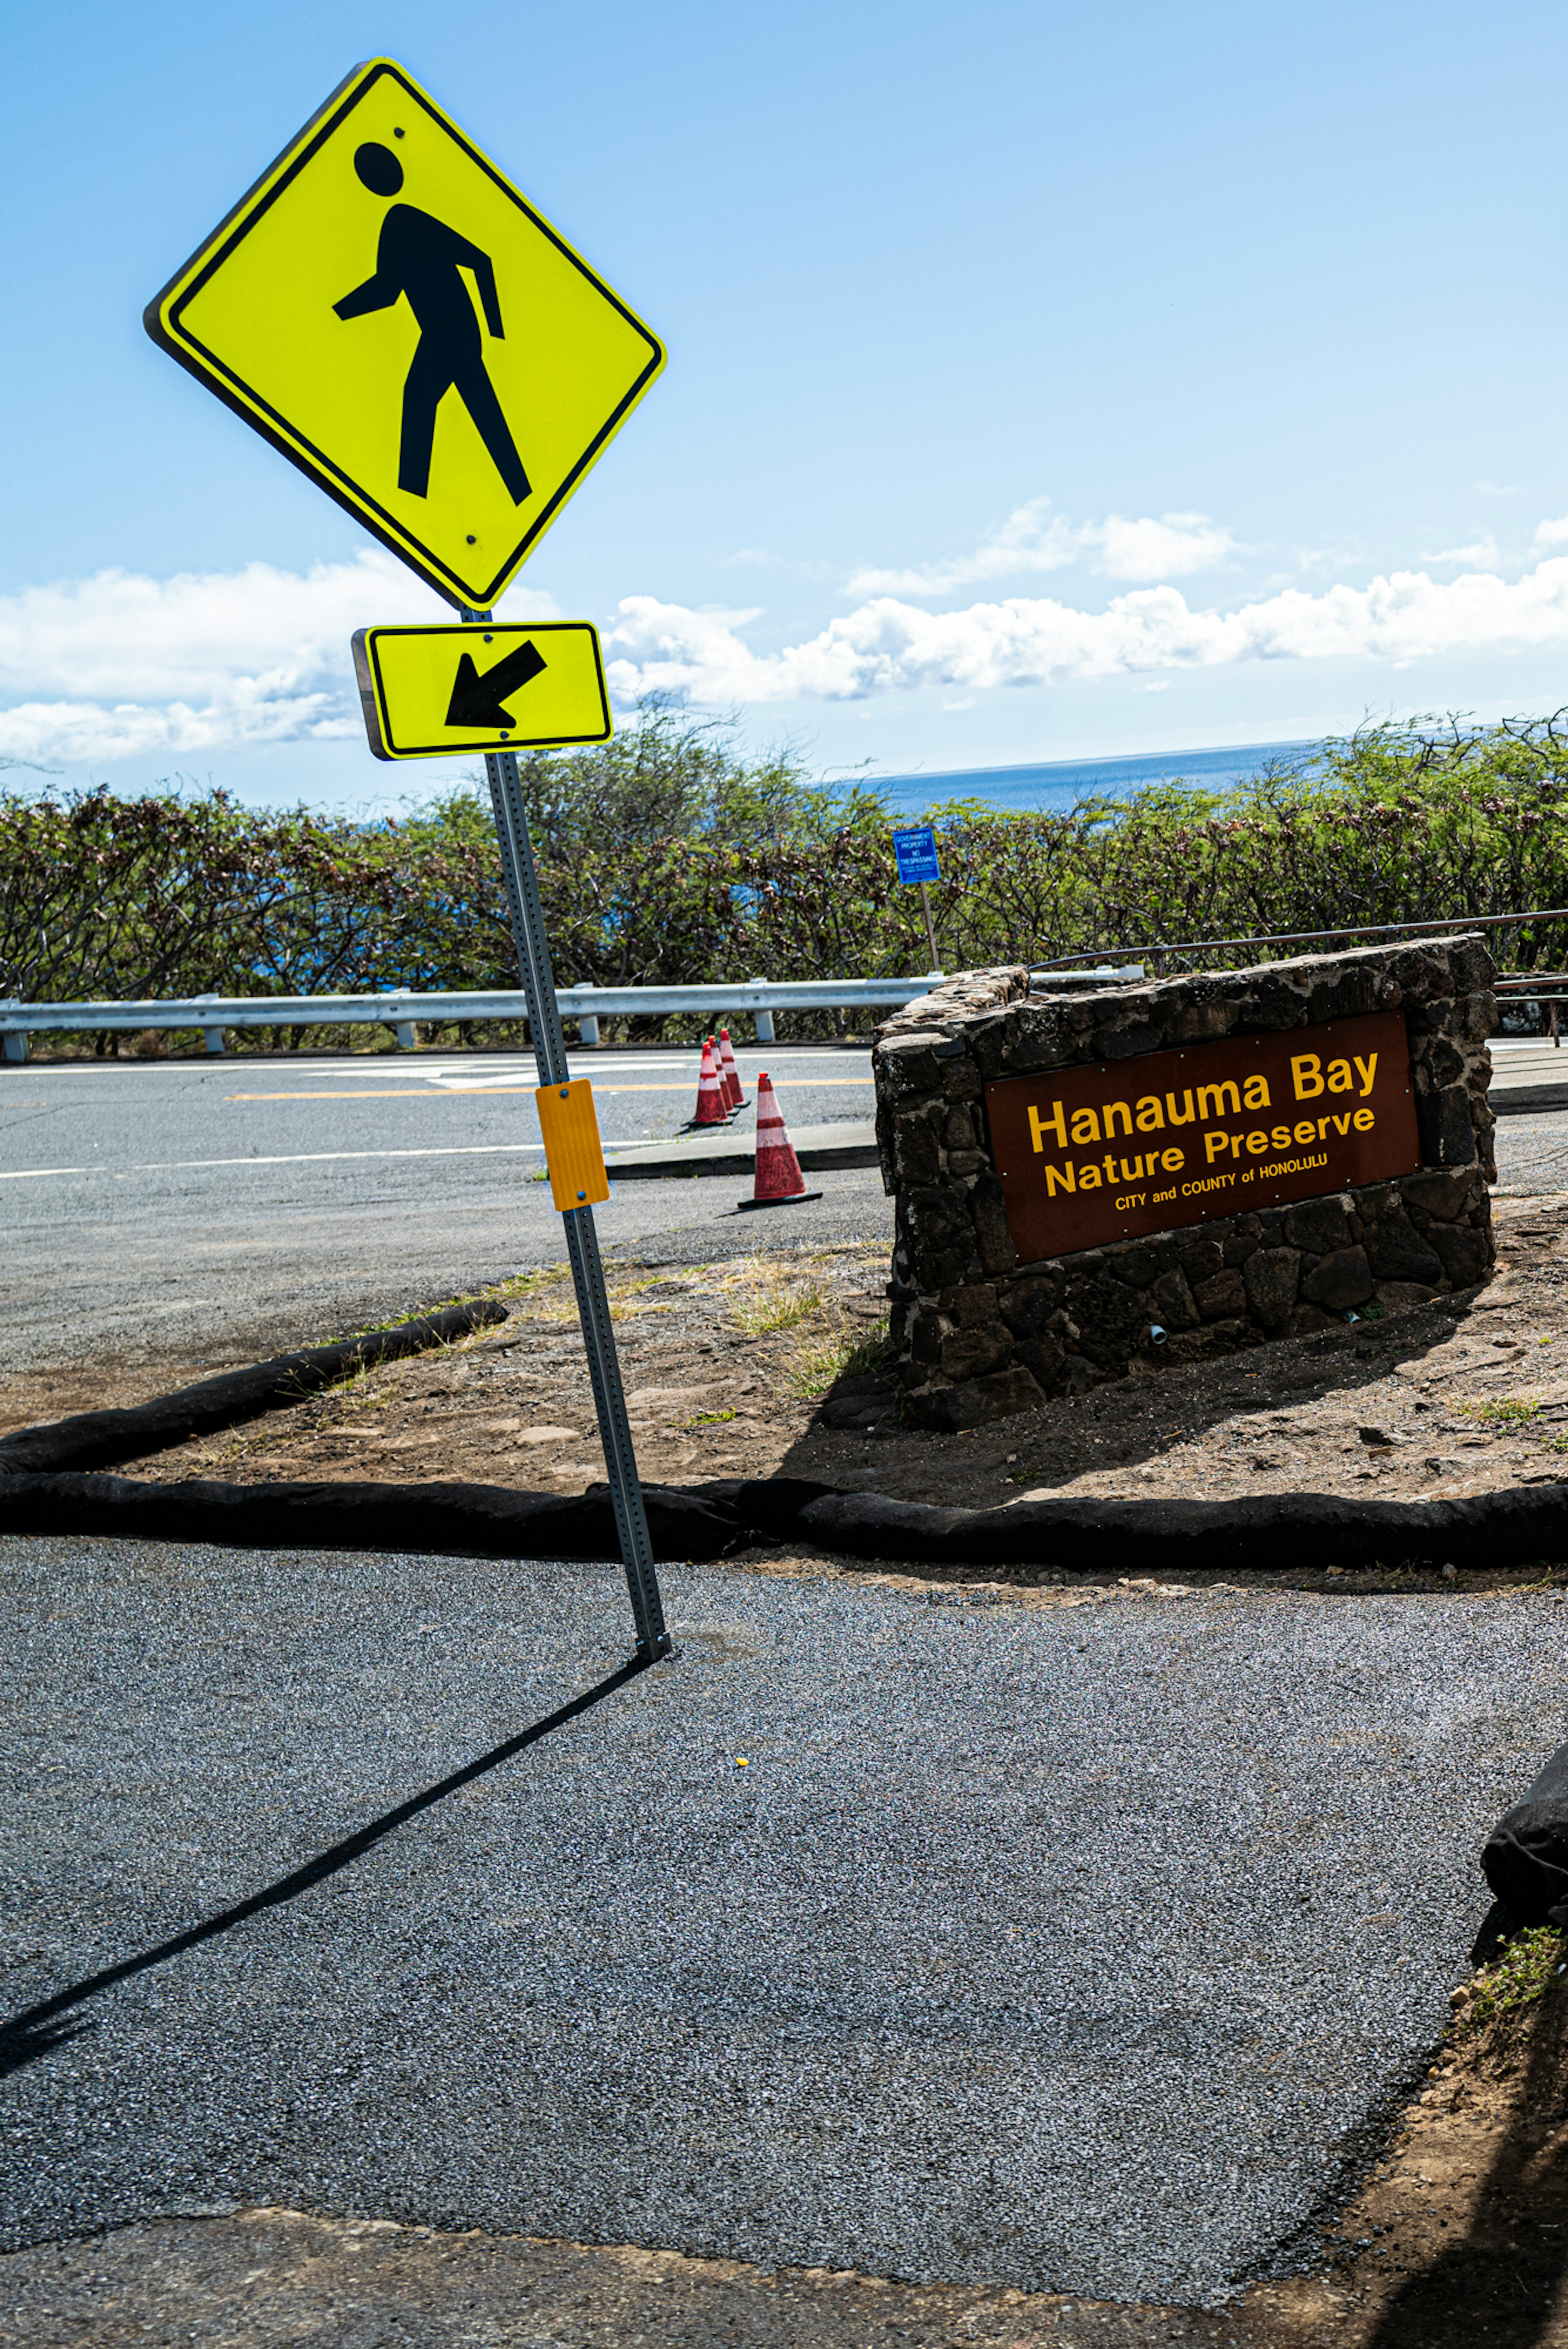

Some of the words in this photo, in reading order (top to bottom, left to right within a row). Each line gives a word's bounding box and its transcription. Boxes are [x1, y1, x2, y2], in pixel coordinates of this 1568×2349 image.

[1027, 1075, 1272, 1153] Hanauma
[1290, 1053, 1378, 1100] Bay
[1045, 1147, 1185, 1197] Nature
[1204, 1108, 1375, 1163] Preserve
[1115, 1193, 1146, 1211] CITY
[1152, 1187, 1177, 1203] and
[1182, 1173, 1236, 1196] COUNTY
[1242, 1169, 1254, 1183] of
[1259, 1153, 1327, 1179] HONOLULU
